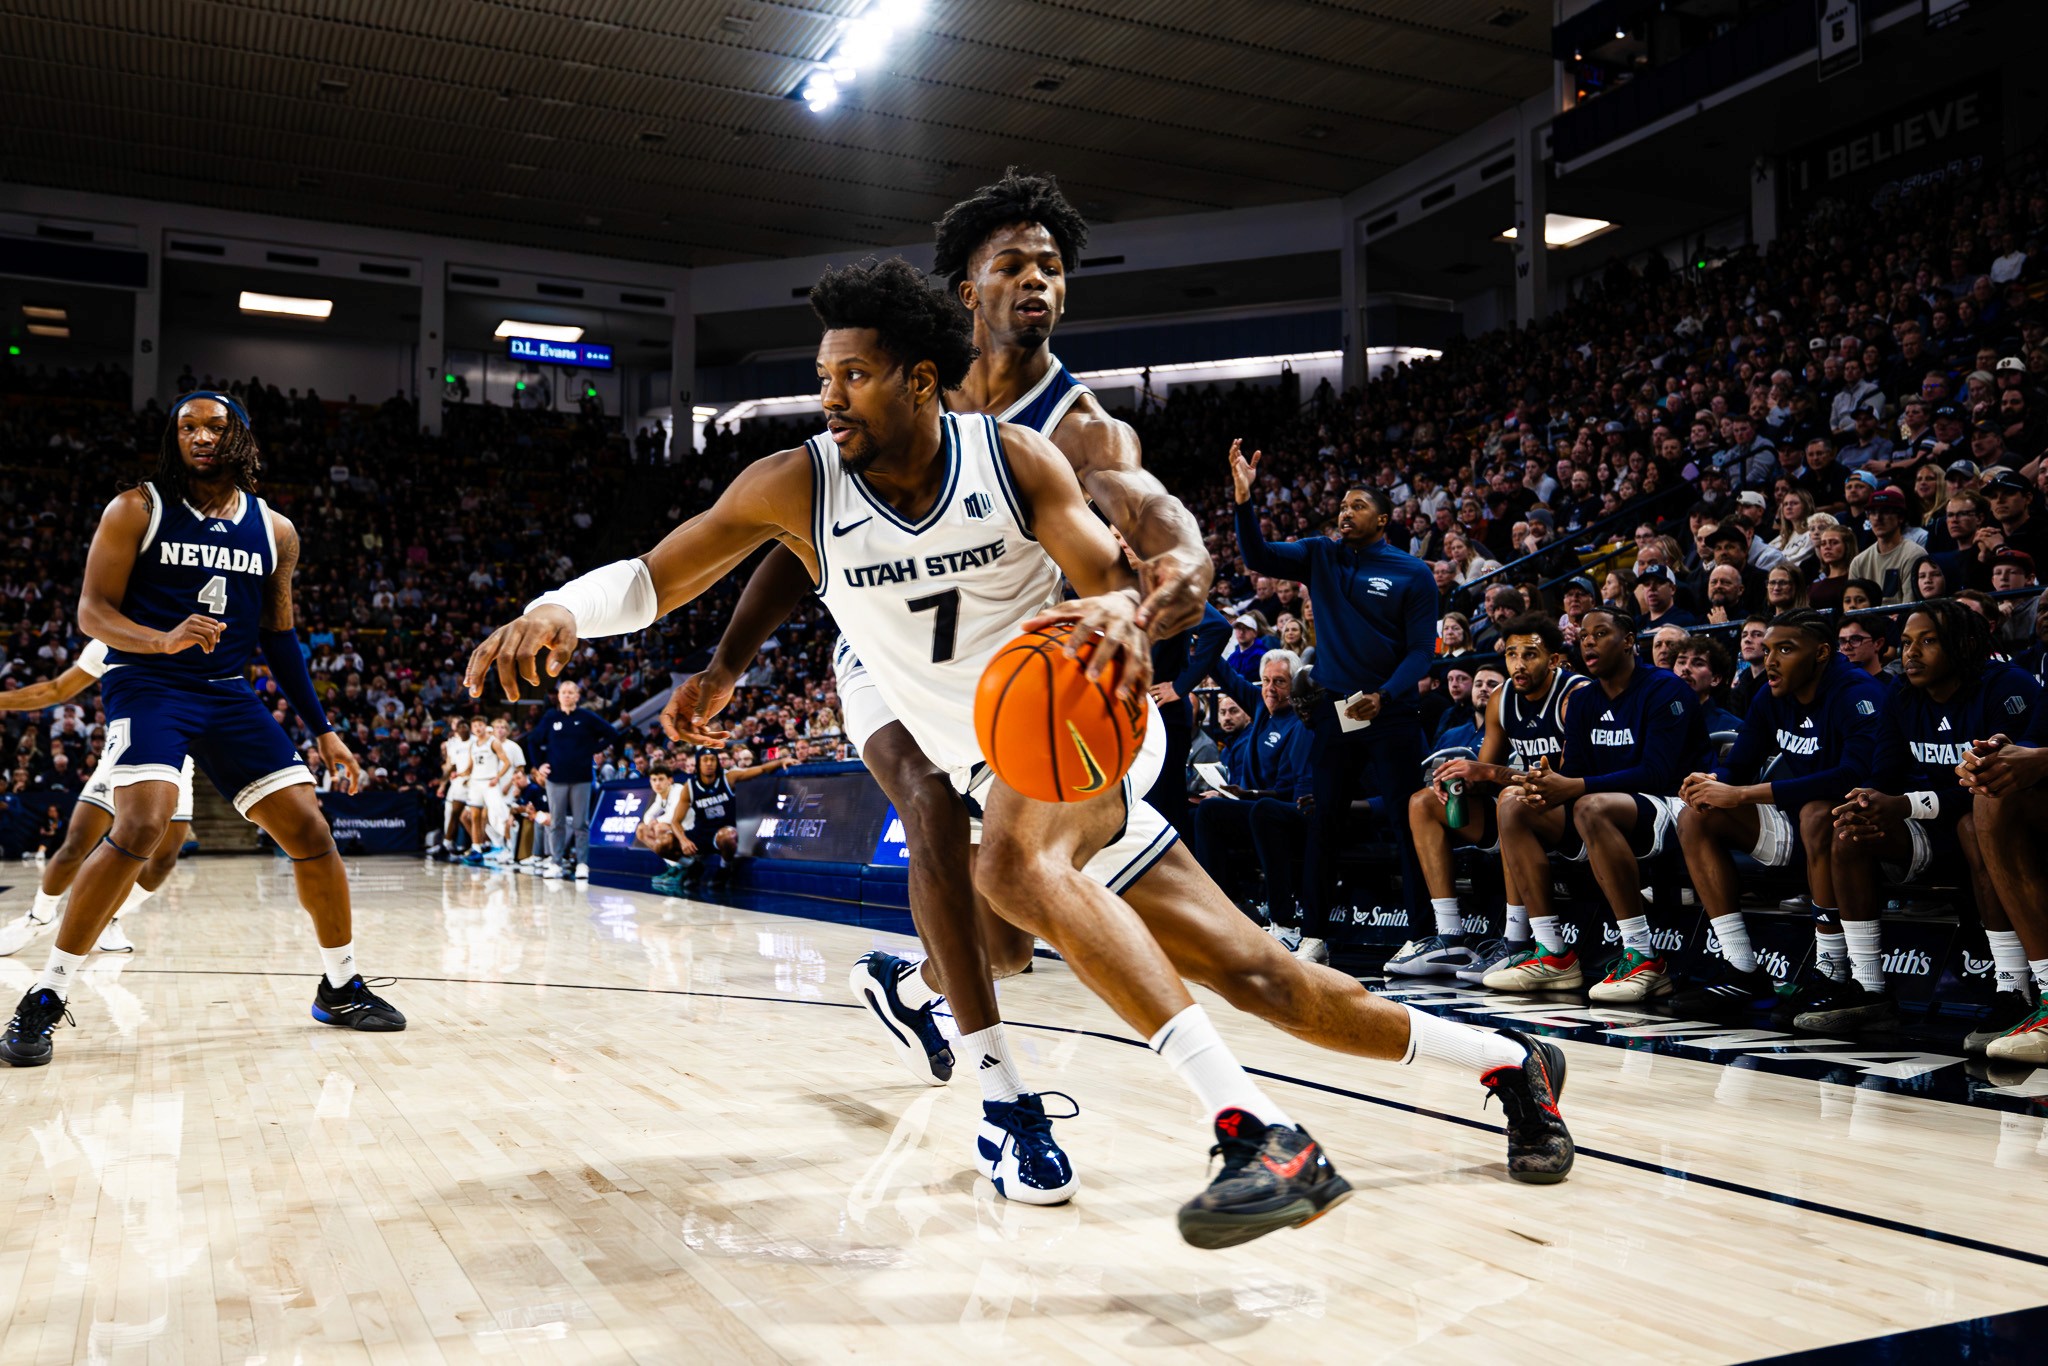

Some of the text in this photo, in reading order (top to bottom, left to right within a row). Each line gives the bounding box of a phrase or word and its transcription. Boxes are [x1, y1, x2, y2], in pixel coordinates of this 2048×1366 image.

[1826, 93, 1981, 181] BELIEVE
[539, 343, 577, 360] Evans
[160, 541, 263, 576] NEVADA
[843, 535, 1007, 588] UTAH STATE
[197, 575, 228, 615] 4
[904, 586, 961, 664] 7
[1909, 741, 1974, 765] NEVAD
[1450, 780, 1464, 796] G
[333, 817, 406, 828] termountain
